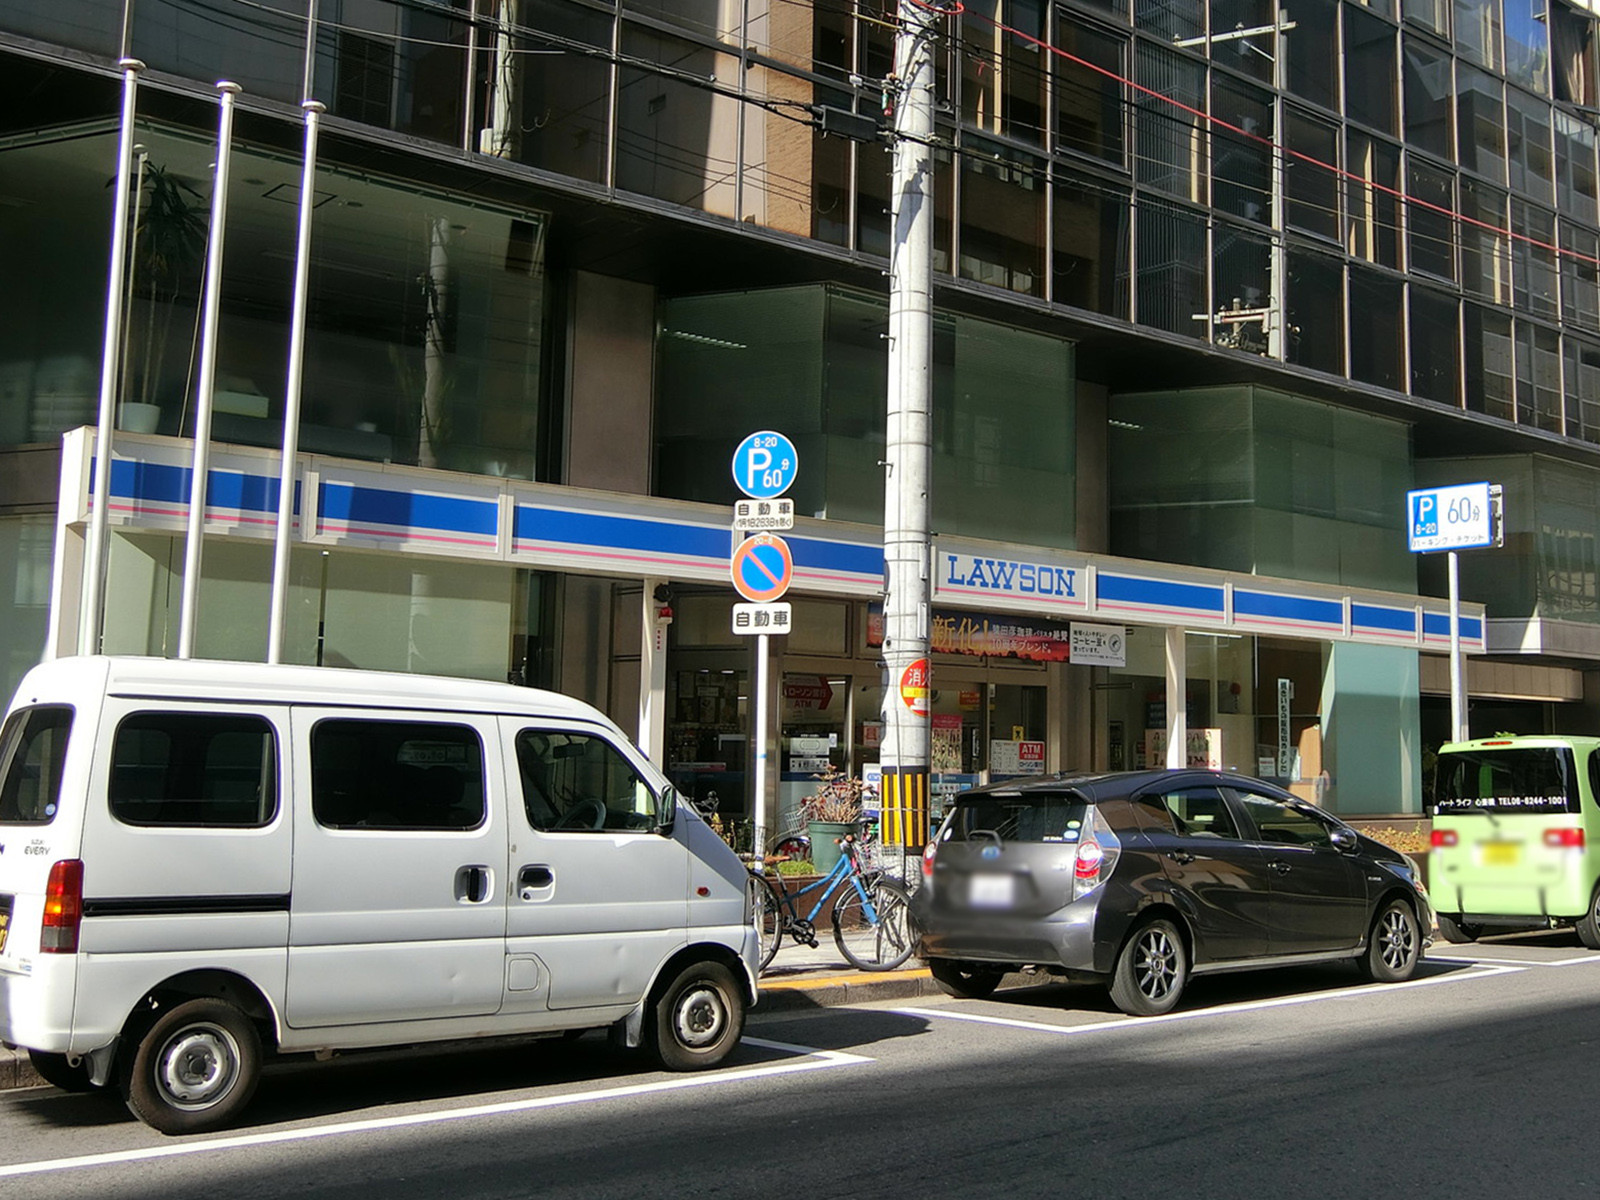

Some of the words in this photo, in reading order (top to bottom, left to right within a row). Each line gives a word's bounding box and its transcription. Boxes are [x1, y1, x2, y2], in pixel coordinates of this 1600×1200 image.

[754, 436, 778, 448] 8-20
[747, 448, 772, 489] P
[738, 502, 791, 516] 自動車
[1420, 496, 1434, 522] P
[1447, 496, 1481, 524] 60分
[1415, 522, 1437, 535] 8-20
[947, 555, 1076, 597] LAWSON
[736, 610, 789, 627] 自動車
[1021, 744, 1041, 754] ATM
[24, 846, 51, 855] EVERY
